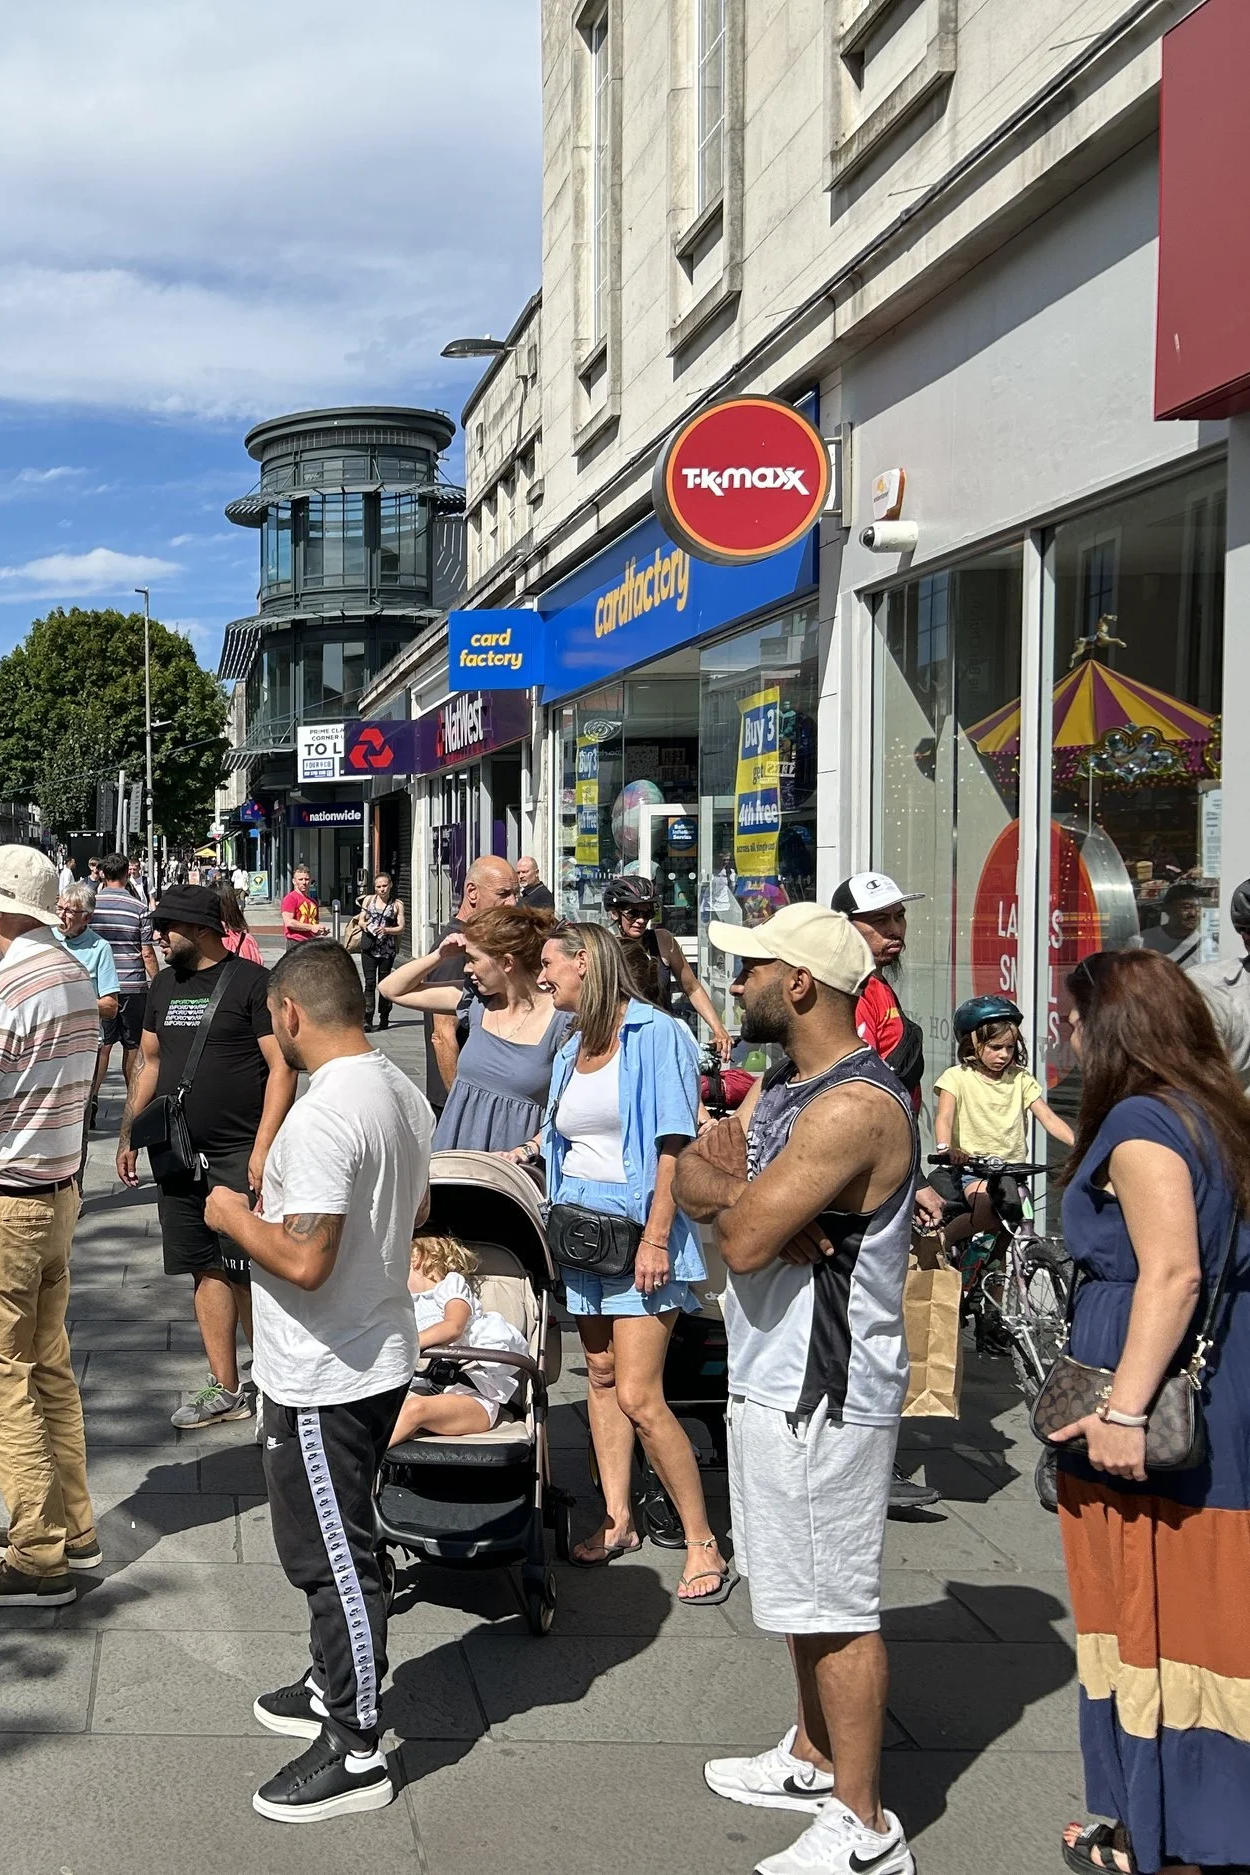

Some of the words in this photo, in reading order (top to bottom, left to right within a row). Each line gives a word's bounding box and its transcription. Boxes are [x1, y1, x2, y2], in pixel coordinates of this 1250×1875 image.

[471, 628, 512, 647] card
[459, 649, 523, 670] factory
[445, 691, 483, 754] NatWest
[744, 717, 765, 754] Buy
[767, 709, 775, 741] 3
[304, 743, 327, 756] TO
[310, 810, 361, 822] nationwide
[738, 801, 755, 827] 4th
[756, 800, 778, 825] free
